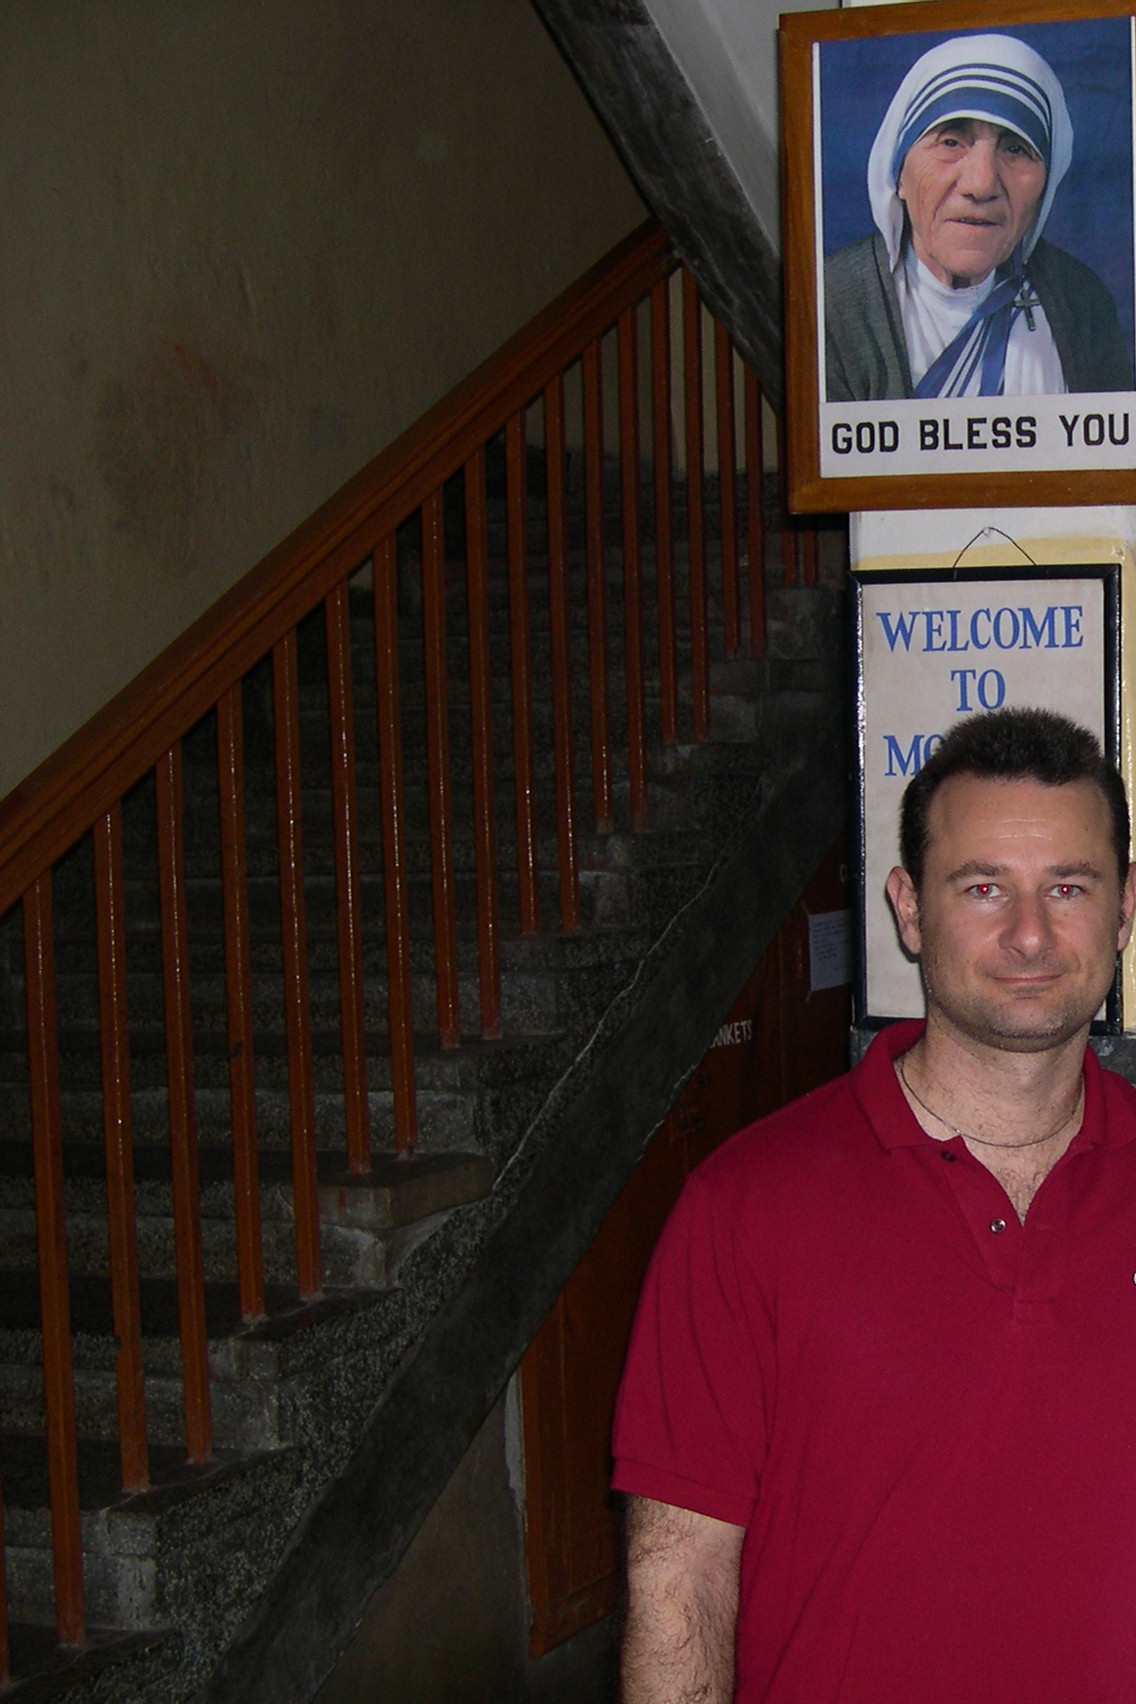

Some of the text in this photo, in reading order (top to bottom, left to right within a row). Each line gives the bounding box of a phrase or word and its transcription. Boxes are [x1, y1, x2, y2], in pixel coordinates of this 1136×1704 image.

[832, 413, 1130, 455] GOD BLESS YOU
[876, 605, 1084, 652] WELCOME
[951, 669, 1006, 711] TO
[709, 1019, 753, 1049] ANKETS
